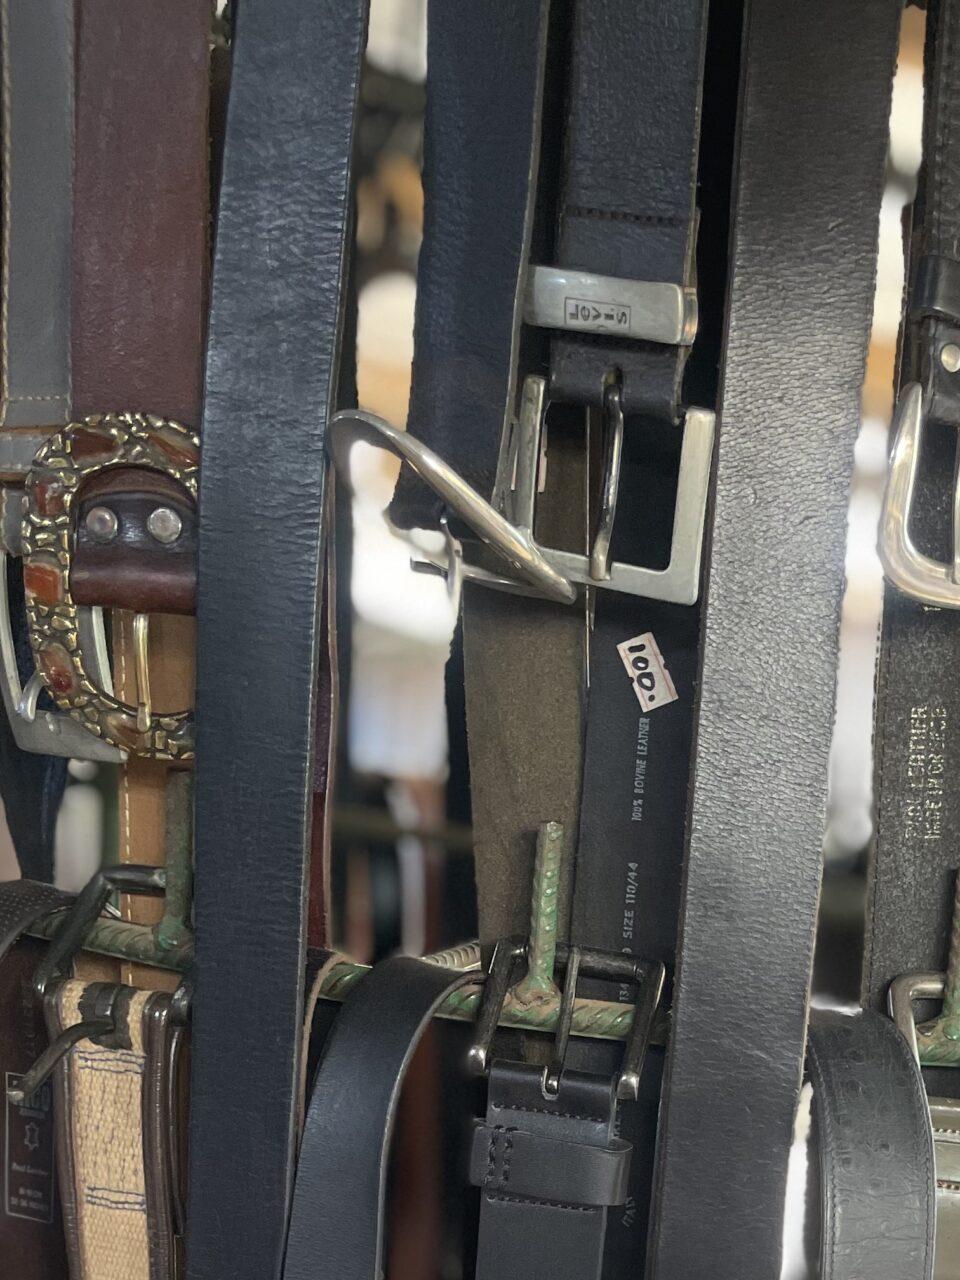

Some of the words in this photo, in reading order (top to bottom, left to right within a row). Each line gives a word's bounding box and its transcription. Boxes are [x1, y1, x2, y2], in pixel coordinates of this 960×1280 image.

[637, 717, 651, 756] LEATHER
[908, 706, 927, 788] LEATHER
[633, 758, 647, 794] BOVINE
[631, 799, 643, 822] 100%
[625, 862, 639, 904] 110/44
[622, 909, 635, 940] SIZE
